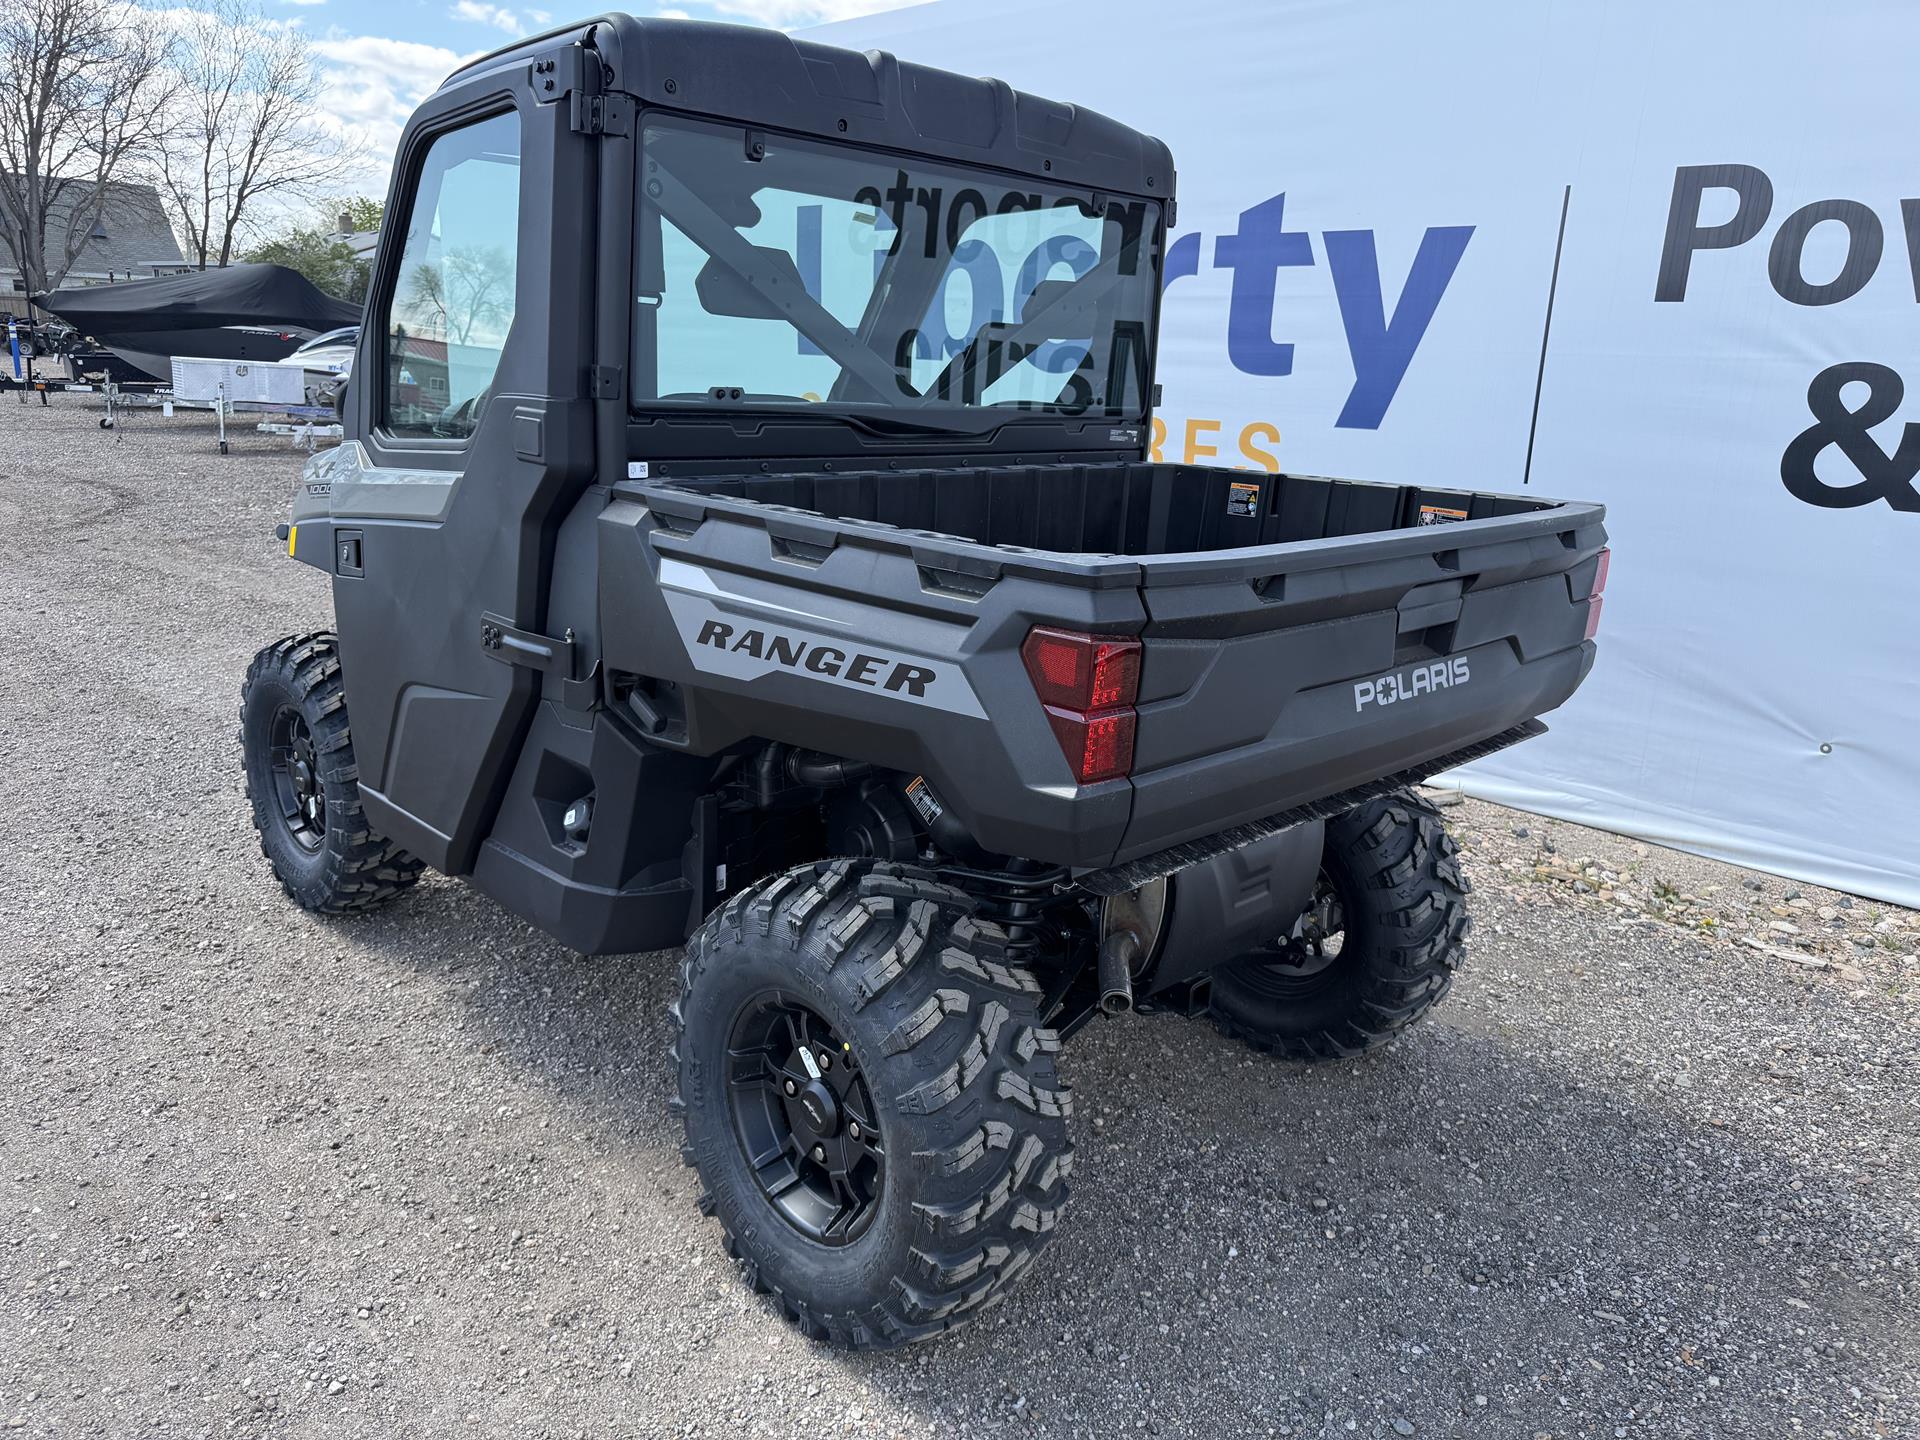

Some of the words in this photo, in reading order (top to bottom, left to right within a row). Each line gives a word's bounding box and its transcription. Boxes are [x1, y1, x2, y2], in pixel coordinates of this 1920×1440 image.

[1653, 163, 1920, 307] Po
[796, 192, 1477, 430] Lbety
[696, 619, 937, 698] RANGER
[1353, 656, 1470, 712] POLARIS
